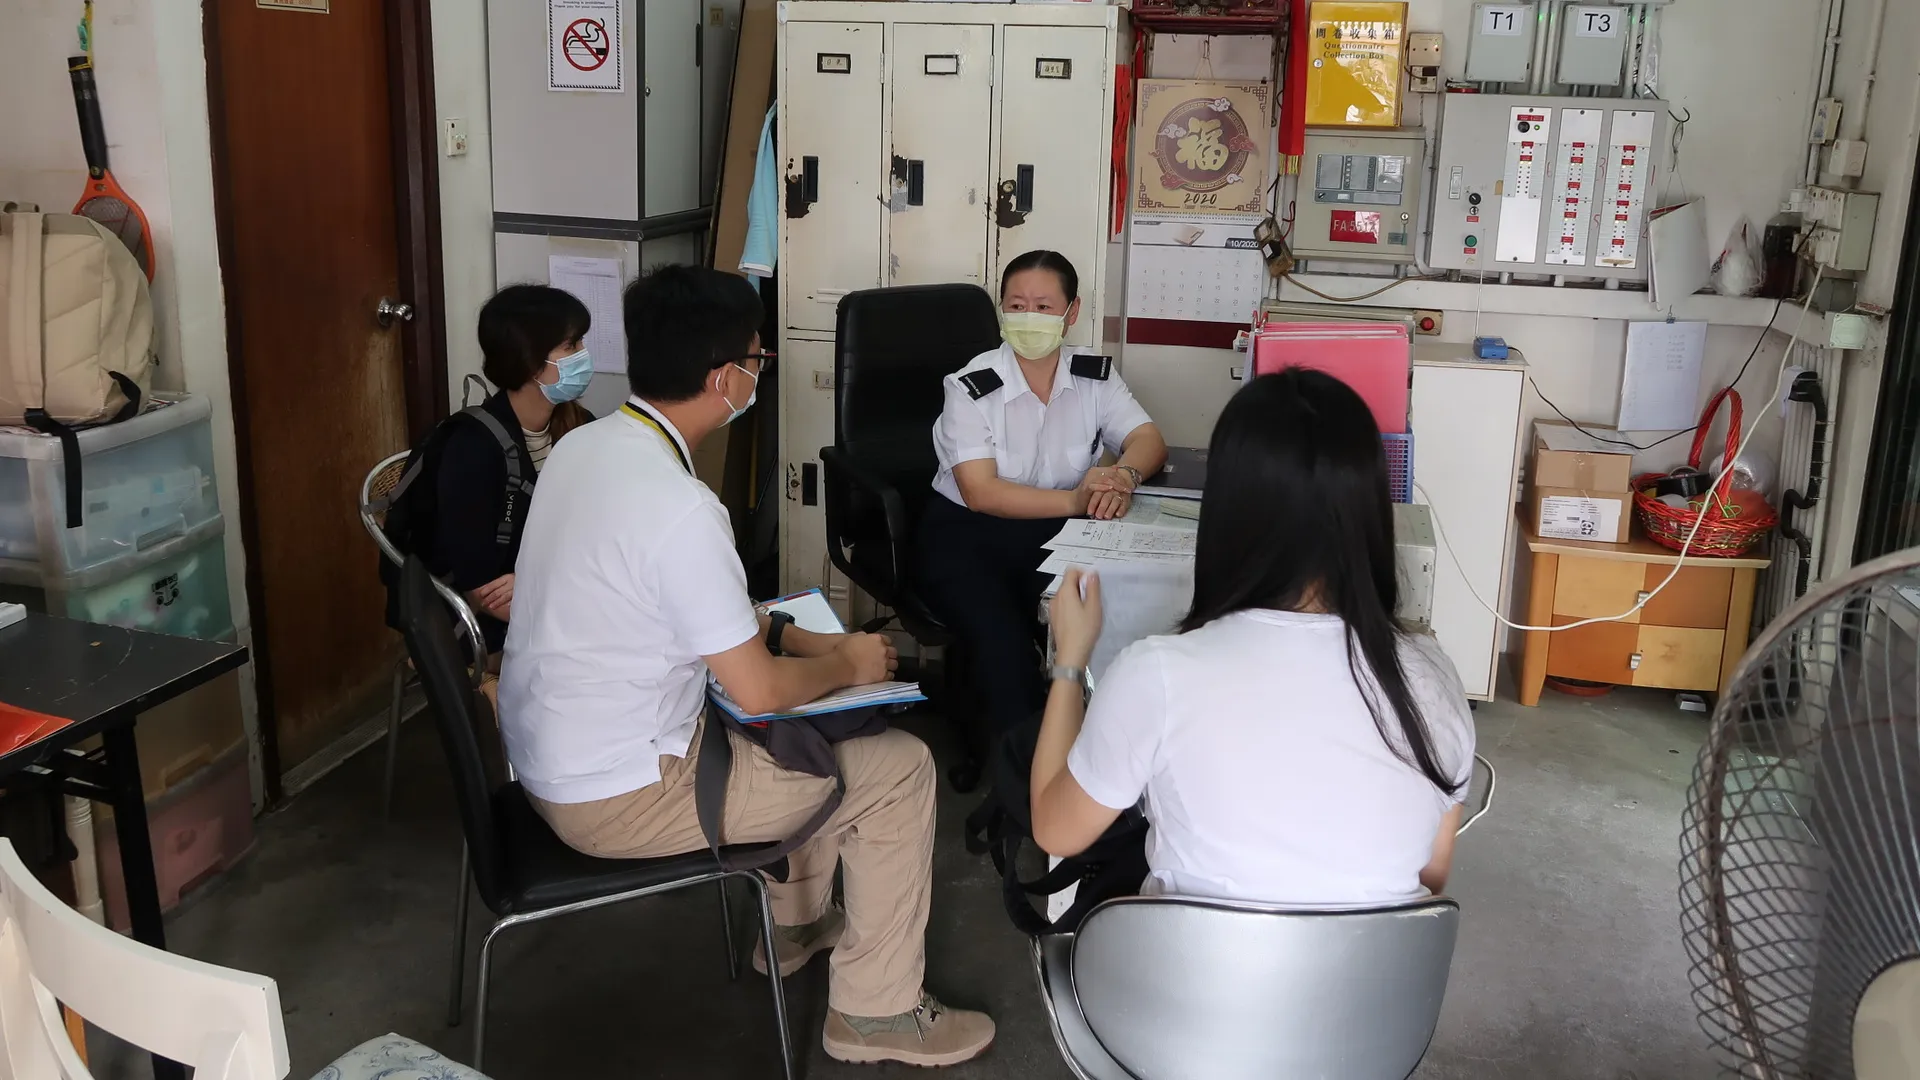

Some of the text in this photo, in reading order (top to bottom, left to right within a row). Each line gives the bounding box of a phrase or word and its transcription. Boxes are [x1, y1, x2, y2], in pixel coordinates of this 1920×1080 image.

[1490, 12, 1514, 30] T1
[1585, 13, 1611, 32] T3
[1316, 28, 1394, 40] 問卷收集箱
[1324, 42, 1384, 50] Questionnaire
[1323, 51, 1366, 59] Collection
[1175, 117, 1229, 171] 福
[1184, 193, 1217, 204] 2020
[1333, 220, 1347, 231] FA
[1231, 240, 1258, 248] 10/2020
